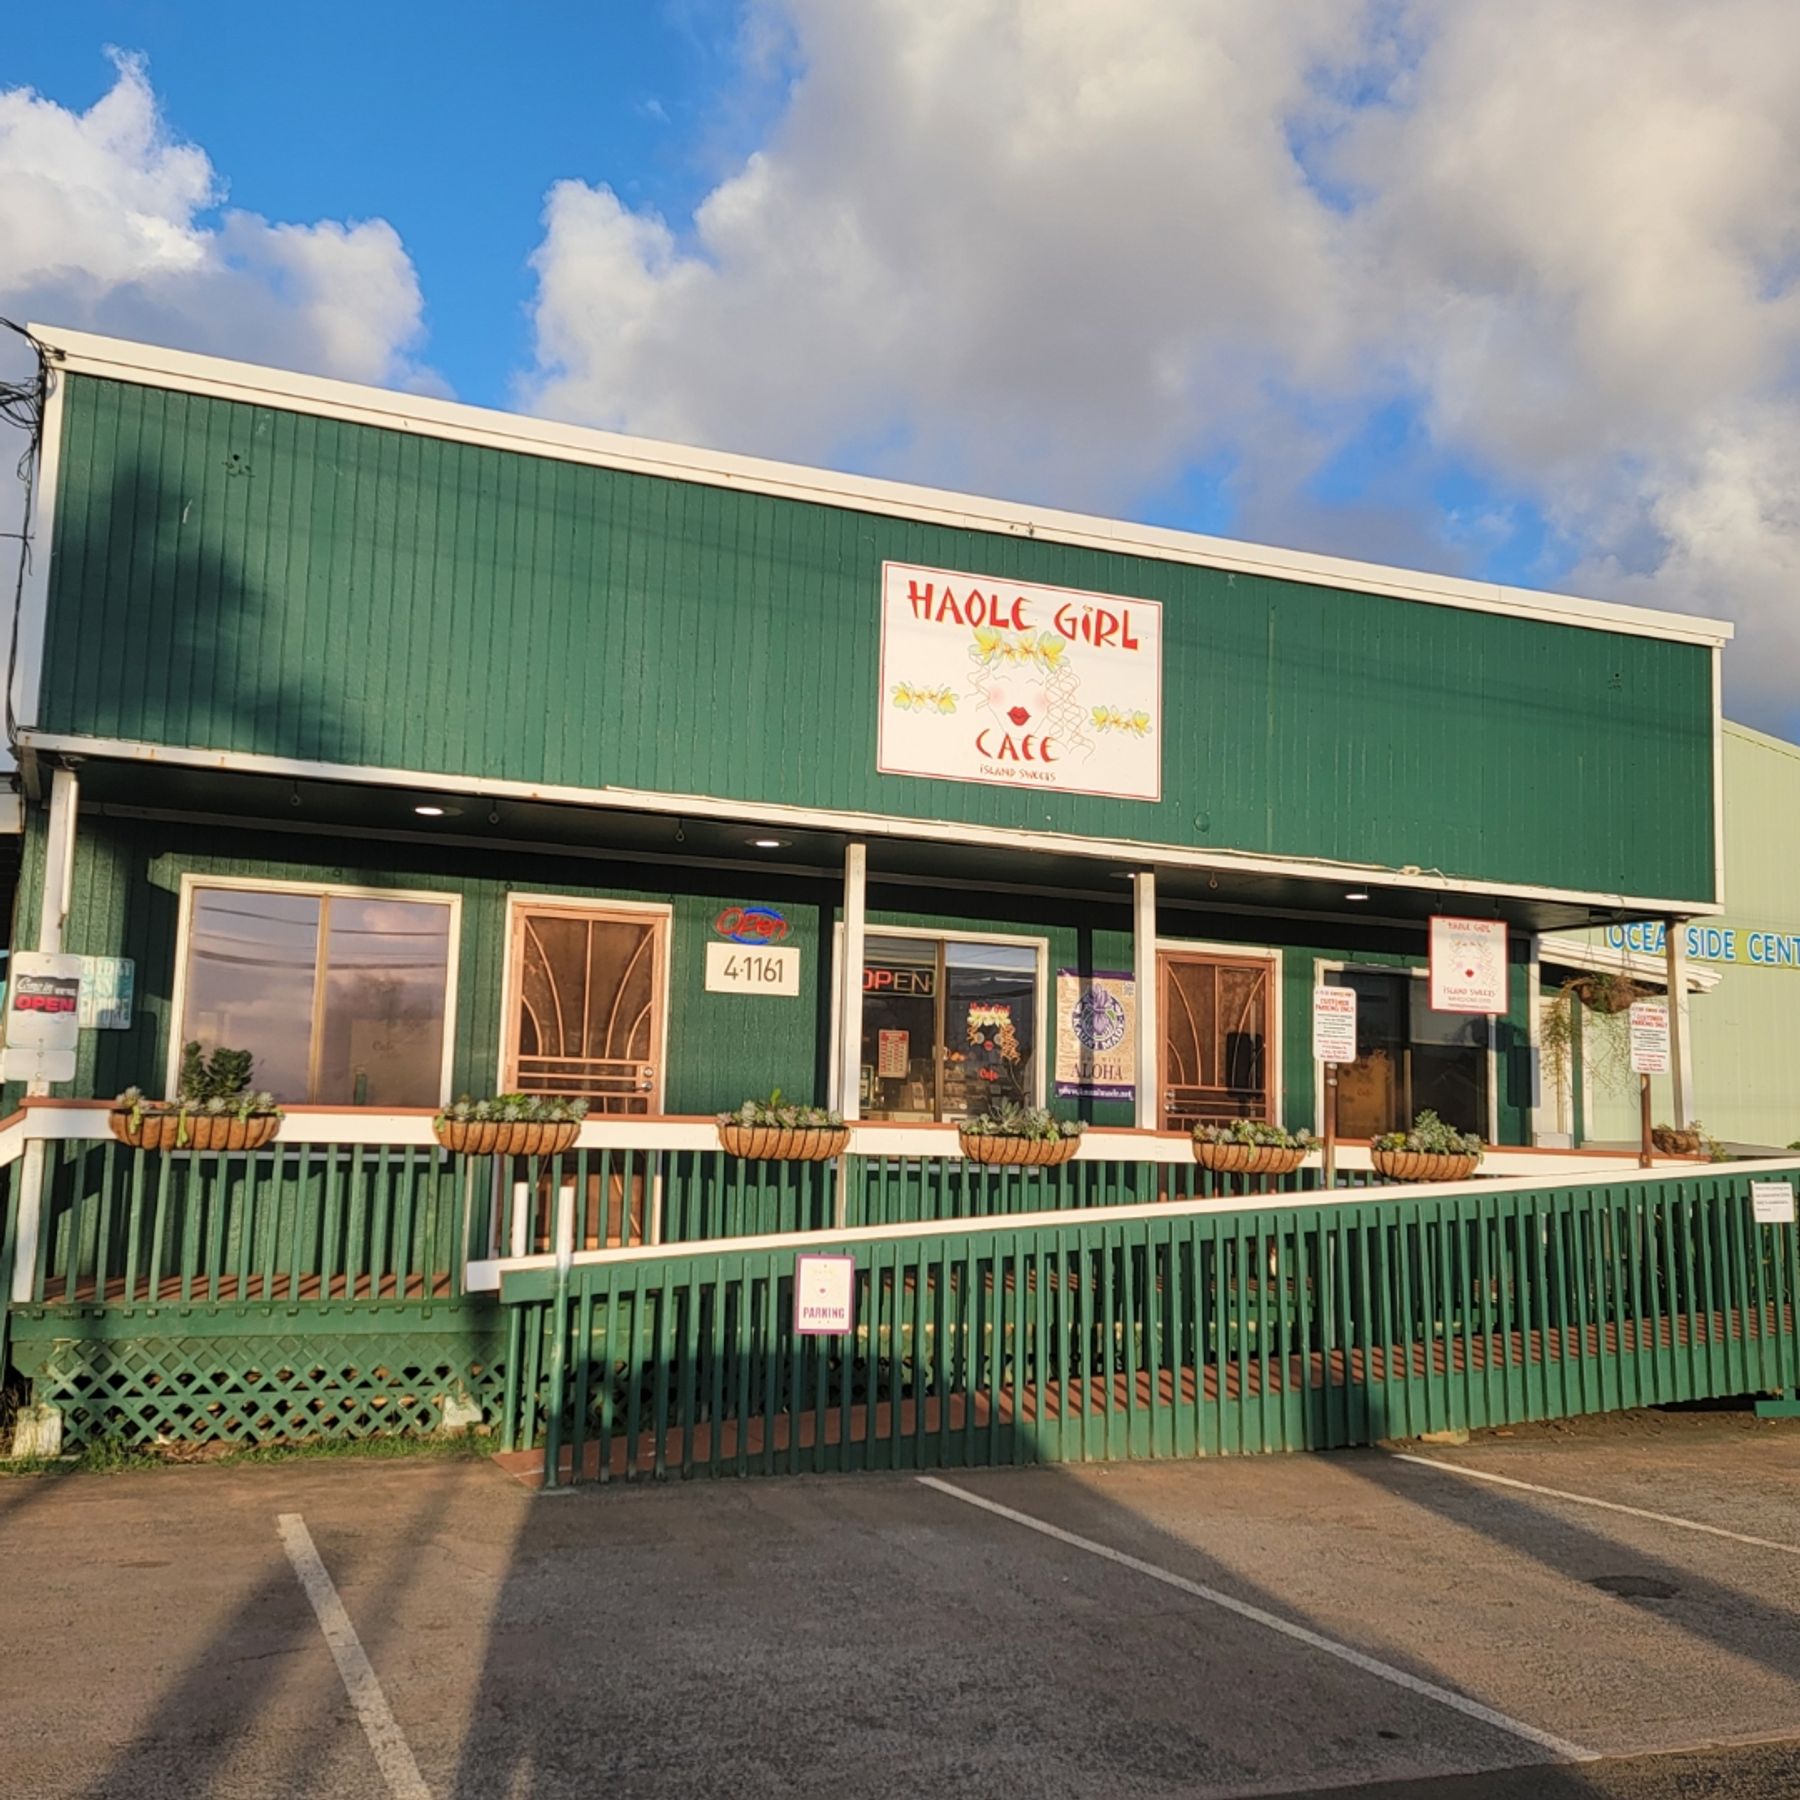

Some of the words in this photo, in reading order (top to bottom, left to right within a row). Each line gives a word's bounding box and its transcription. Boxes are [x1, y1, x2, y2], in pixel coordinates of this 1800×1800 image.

[907, 580, 1036, 632] HAOLE
[1607, 920, 1736, 960] OCEASIDE
[16, 994, 75, 1012] OPEN
[1070, 1062, 1123, 1080] ALOHA
[802, 1306, 845, 1319] PARKING
